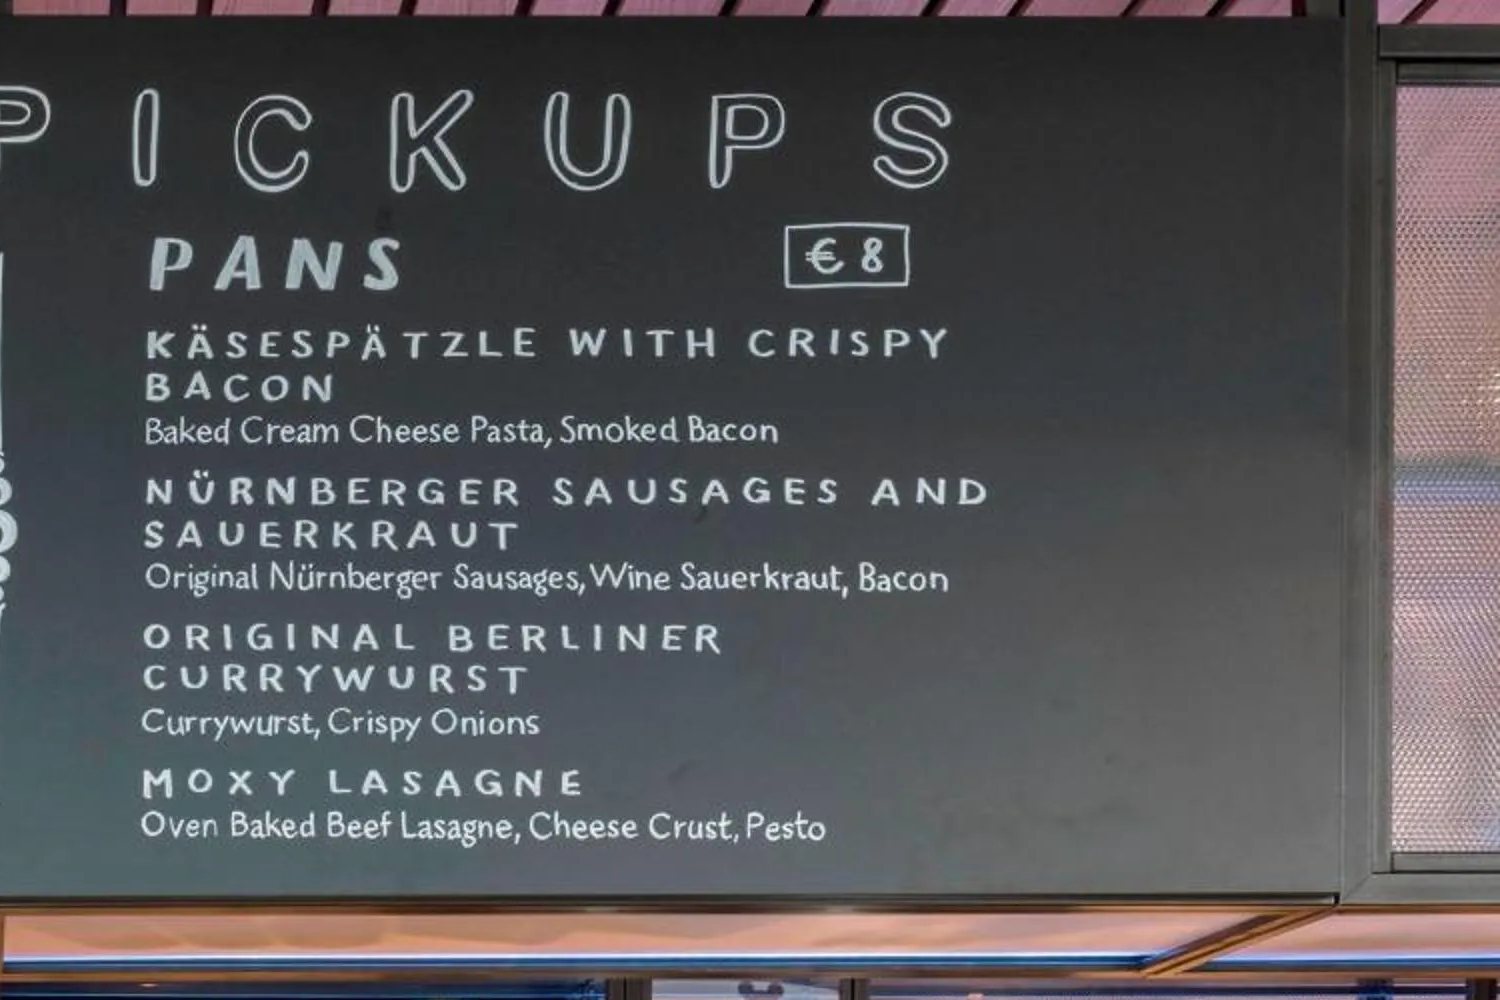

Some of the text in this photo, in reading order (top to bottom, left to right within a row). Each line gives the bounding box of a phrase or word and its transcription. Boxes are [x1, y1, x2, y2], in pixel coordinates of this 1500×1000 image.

[149, 234, 401, 292] PANS
[146, 323, 948, 361] KÄSESPÄTZLE WITH CRISPY
[145, 370, 333, 403] BACON
[145, 414, 779, 449] Baked Cream Cheese Pasta, Smoked Bacon
[145, 469, 987, 507] NÜRNBERGER SAUSAGES AND
[143, 519, 519, 552] SAUERKRAUT
[145, 559, 949, 600] Original Nürnberger Sausages, Wine Sauerkraut, Bacon
[143, 622, 721, 655] ORIGINAL BERLINER
[143, 663, 528, 695] CURRYWURST
[141, 707, 541, 743] Currywurst, Crispy Onions
[142, 767, 581, 800] MOXY LASAGNE
[140, 810, 827, 849] Oven Baked Beef Lasagne, Cheese Crust, Pesto
